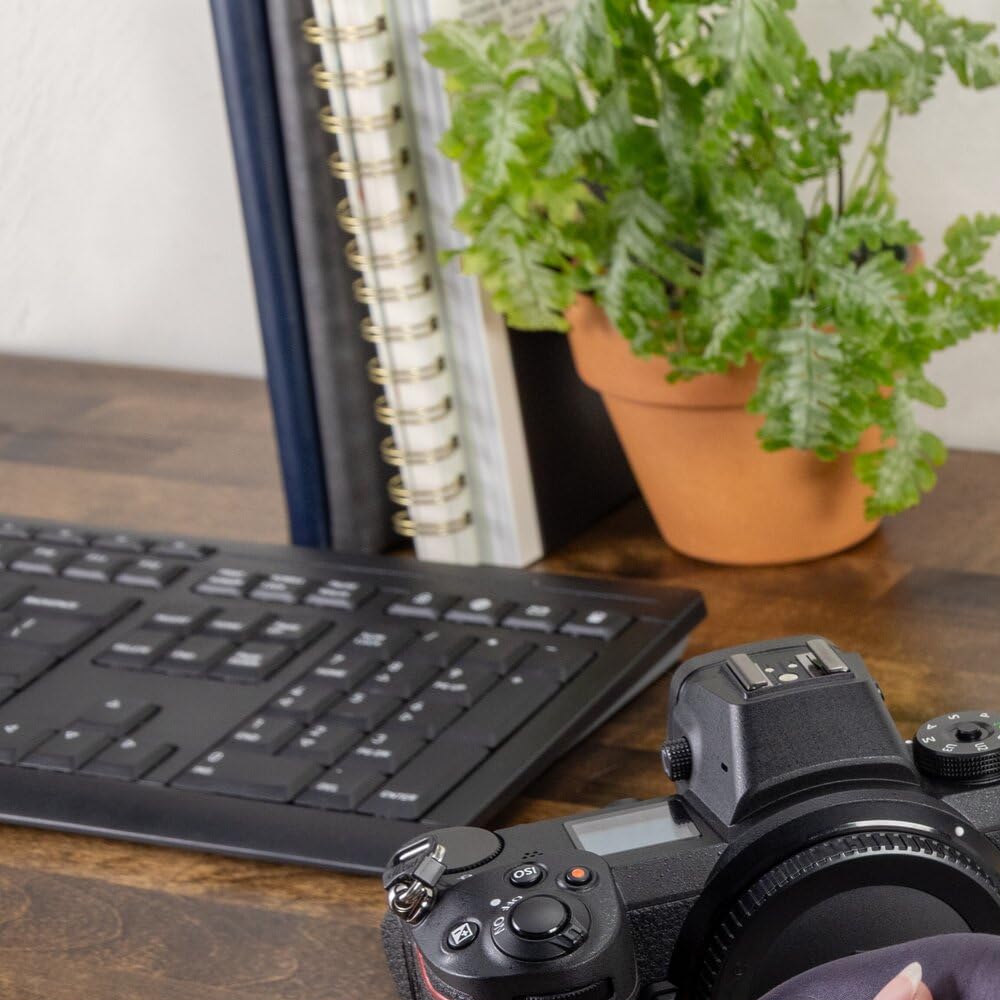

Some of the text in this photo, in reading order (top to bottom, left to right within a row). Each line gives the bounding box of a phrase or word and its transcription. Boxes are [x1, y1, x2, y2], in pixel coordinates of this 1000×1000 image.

[513, 866, 537, 878] ISO
[501, 895, 523, 911] OFF
[493, 916, 504, 935] ON
